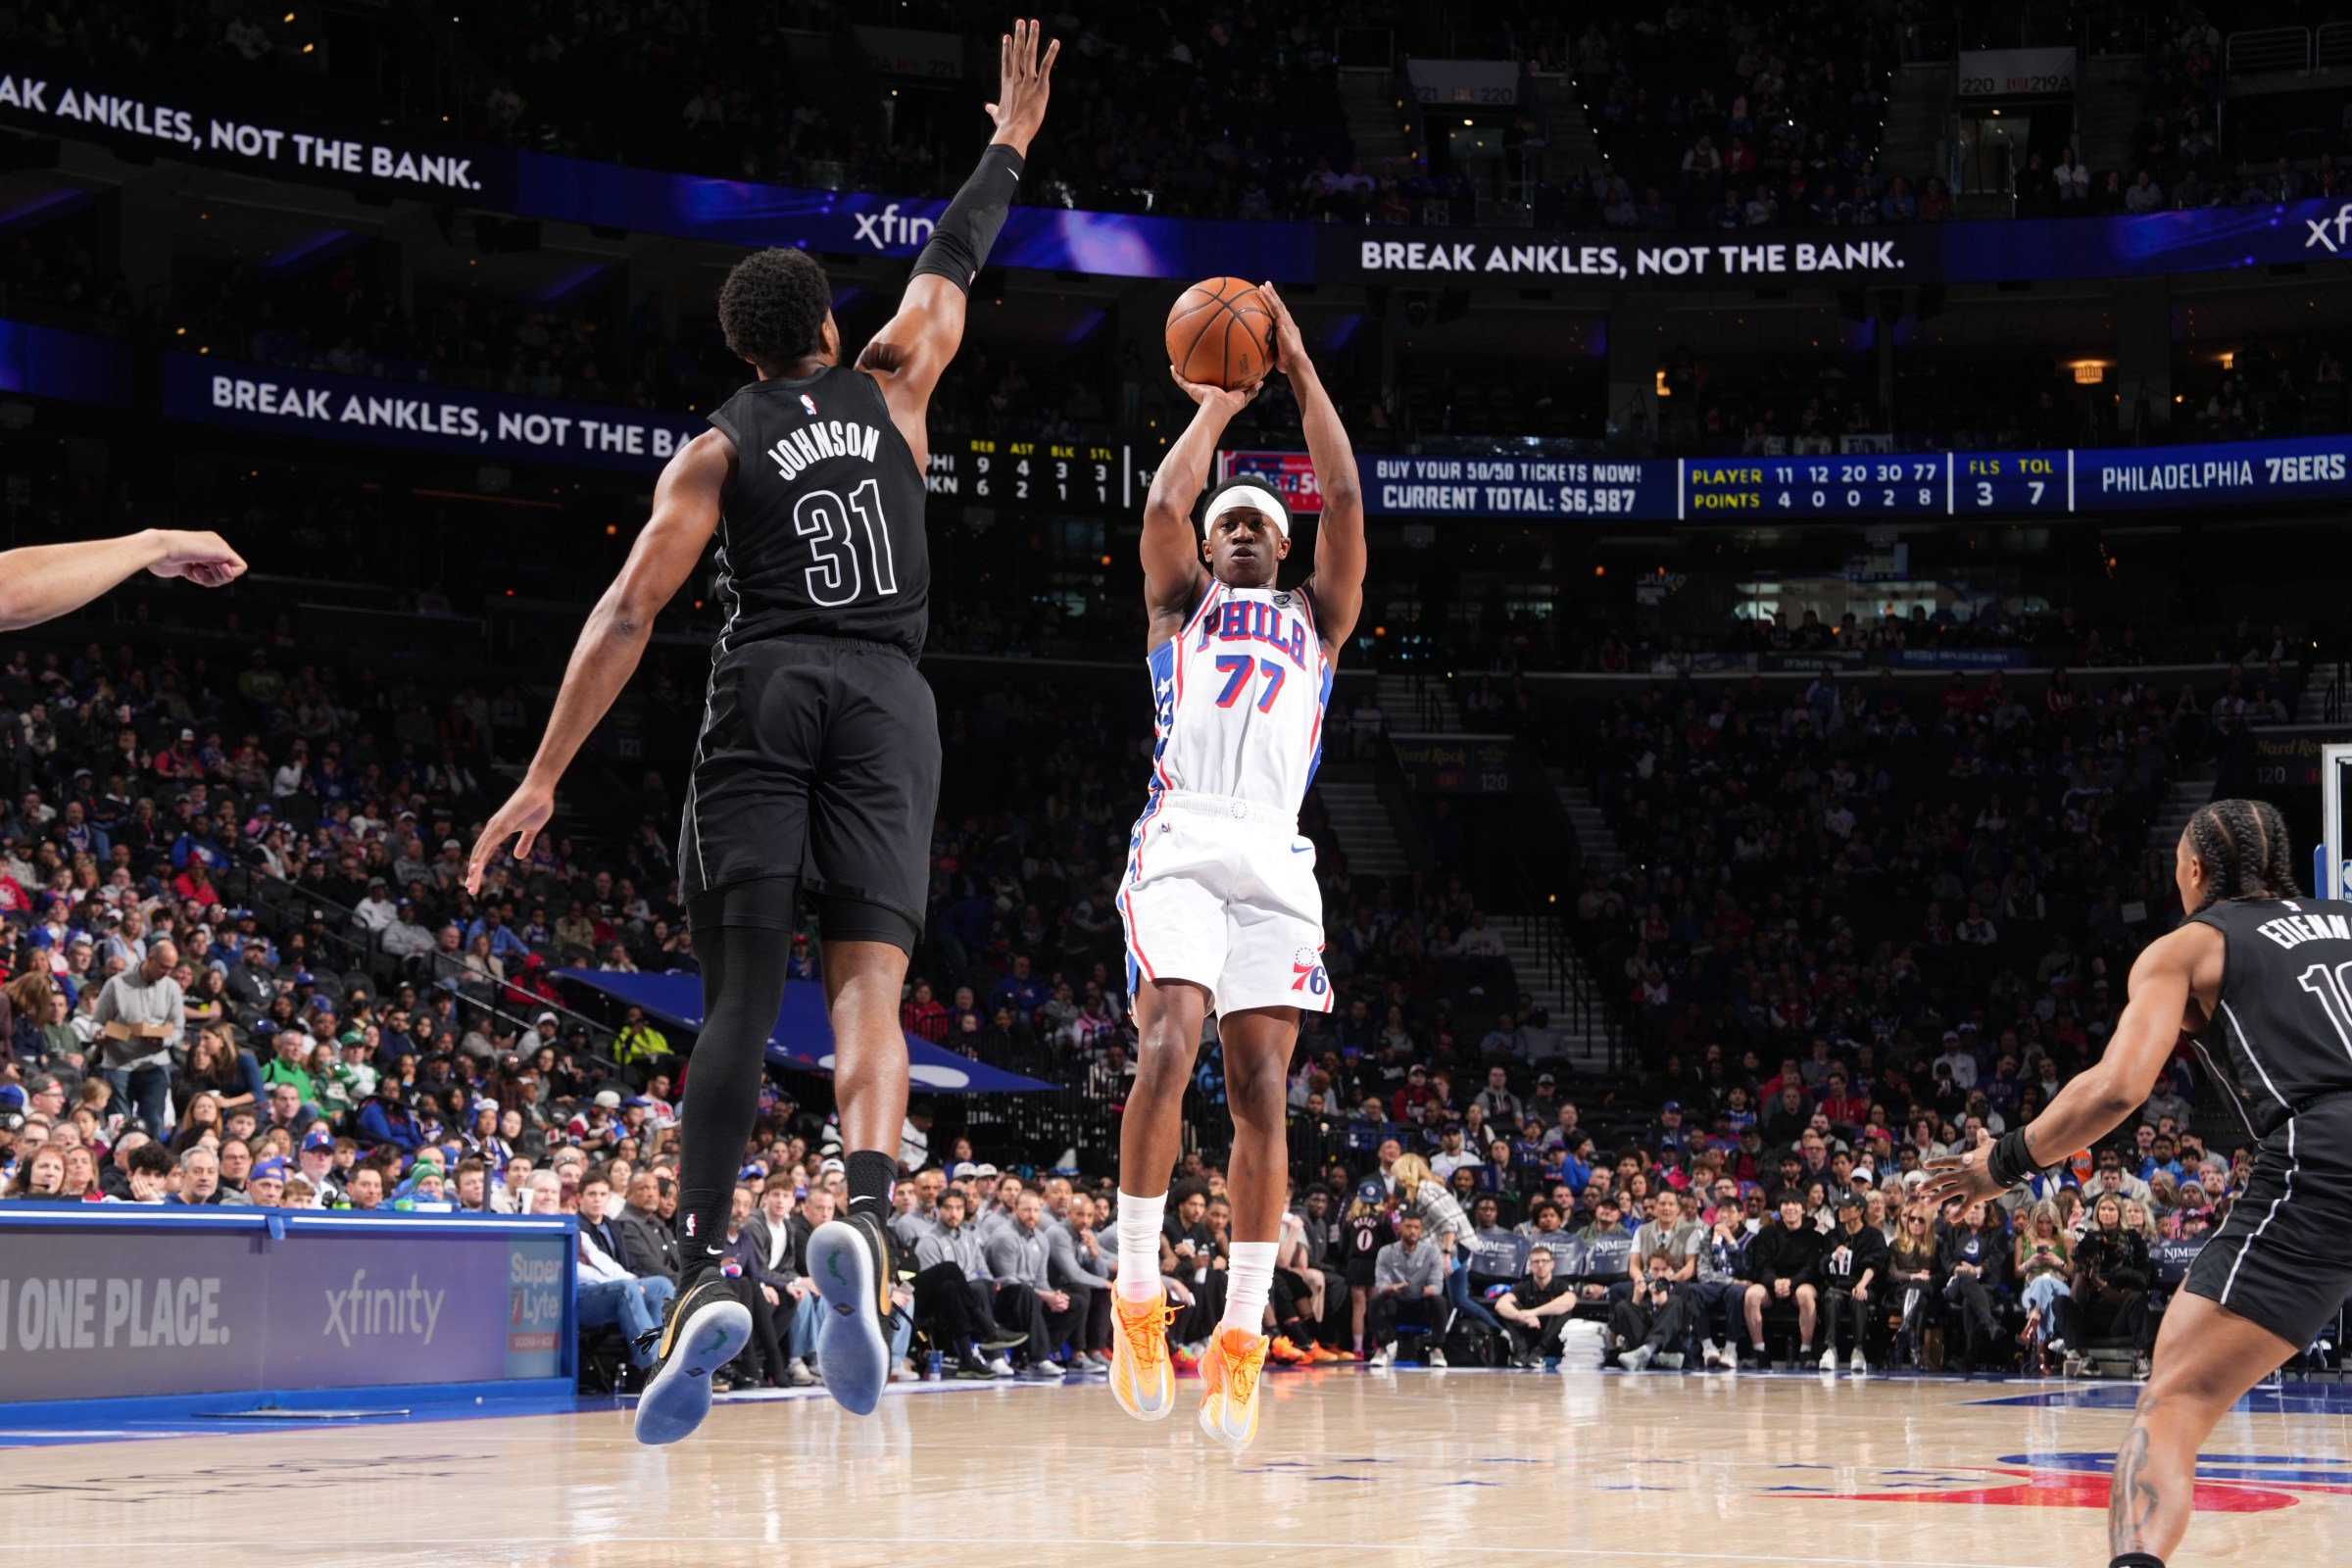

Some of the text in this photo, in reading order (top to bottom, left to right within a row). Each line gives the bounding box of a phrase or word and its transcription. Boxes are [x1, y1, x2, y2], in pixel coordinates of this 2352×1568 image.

[1962, 77, 1994, 93] 220
[55, 87, 202, 150] ANKLES,
[211, 119, 284, 160] NOT
[292, 134, 363, 172] THE
[371, 147, 481, 190] BANK.
[1361, 241, 1905, 280] BREAK ANKLES, NOT THE BANK.
[213, 376, 331, 420] BREAK
[340, 394, 488, 443] ANKLES,
[498, 412, 571, 447] NOT
[579, 419, 645, 455] THE
[767, 420, 880, 481] JOHNSON
[971, 440, 1113, 462] REB AST BLK STL
[977, 457, 990, 474] 9
[1016, 460, 1030, 477] 4
[1055, 462, 1068, 479] 3
[1095, 465, 1107, 482] 3
[1377, 461, 1642, 483] BUY YOUR 50/50 TICKETS NOW!
[1692, 464, 1936, 484] PLAYER 11 12 20 30 77
[1970, 459, 2053, 475] FLS TOL
[2102, 454, 2346, 492] PHILADELPHIA 76ERS
[925, 476, 1106, 504] KN 6 2 1 1
[1383, 485, 1636, 514] CURRENT TOTAL: $6,987
[1694, 488, 1931, 508] POINTS 4 0 0 2 8
[1977, 481, 2044, 506] 3 7
[794, 479, 898, 607] 31
[1196, 600, 1306, 672] PHILA
[1215, 654, 1286, 714] 77
[618, 738, 642, 757] 121
[2257, 739, 2295, 756] Hard
[1480, 774, 1508, 791] 120
[2257, 765, 2285, 784] 120
[1292, 960, 1327, 996] 76
[1356, 1228, 1373, 1252] 0
[1596, 1240, 1617, 1253] NJM
[2164, 1247, 2188, 1260] NJM
[511, 1251, 562, 1290] Super
[18, 1277, 97, 1351] ONE
[104, 1277, 230, 1347] PLACE.
[322, 1268, 445, 1348] xfinity
[523, 1289, 559, 1325] Lyte
